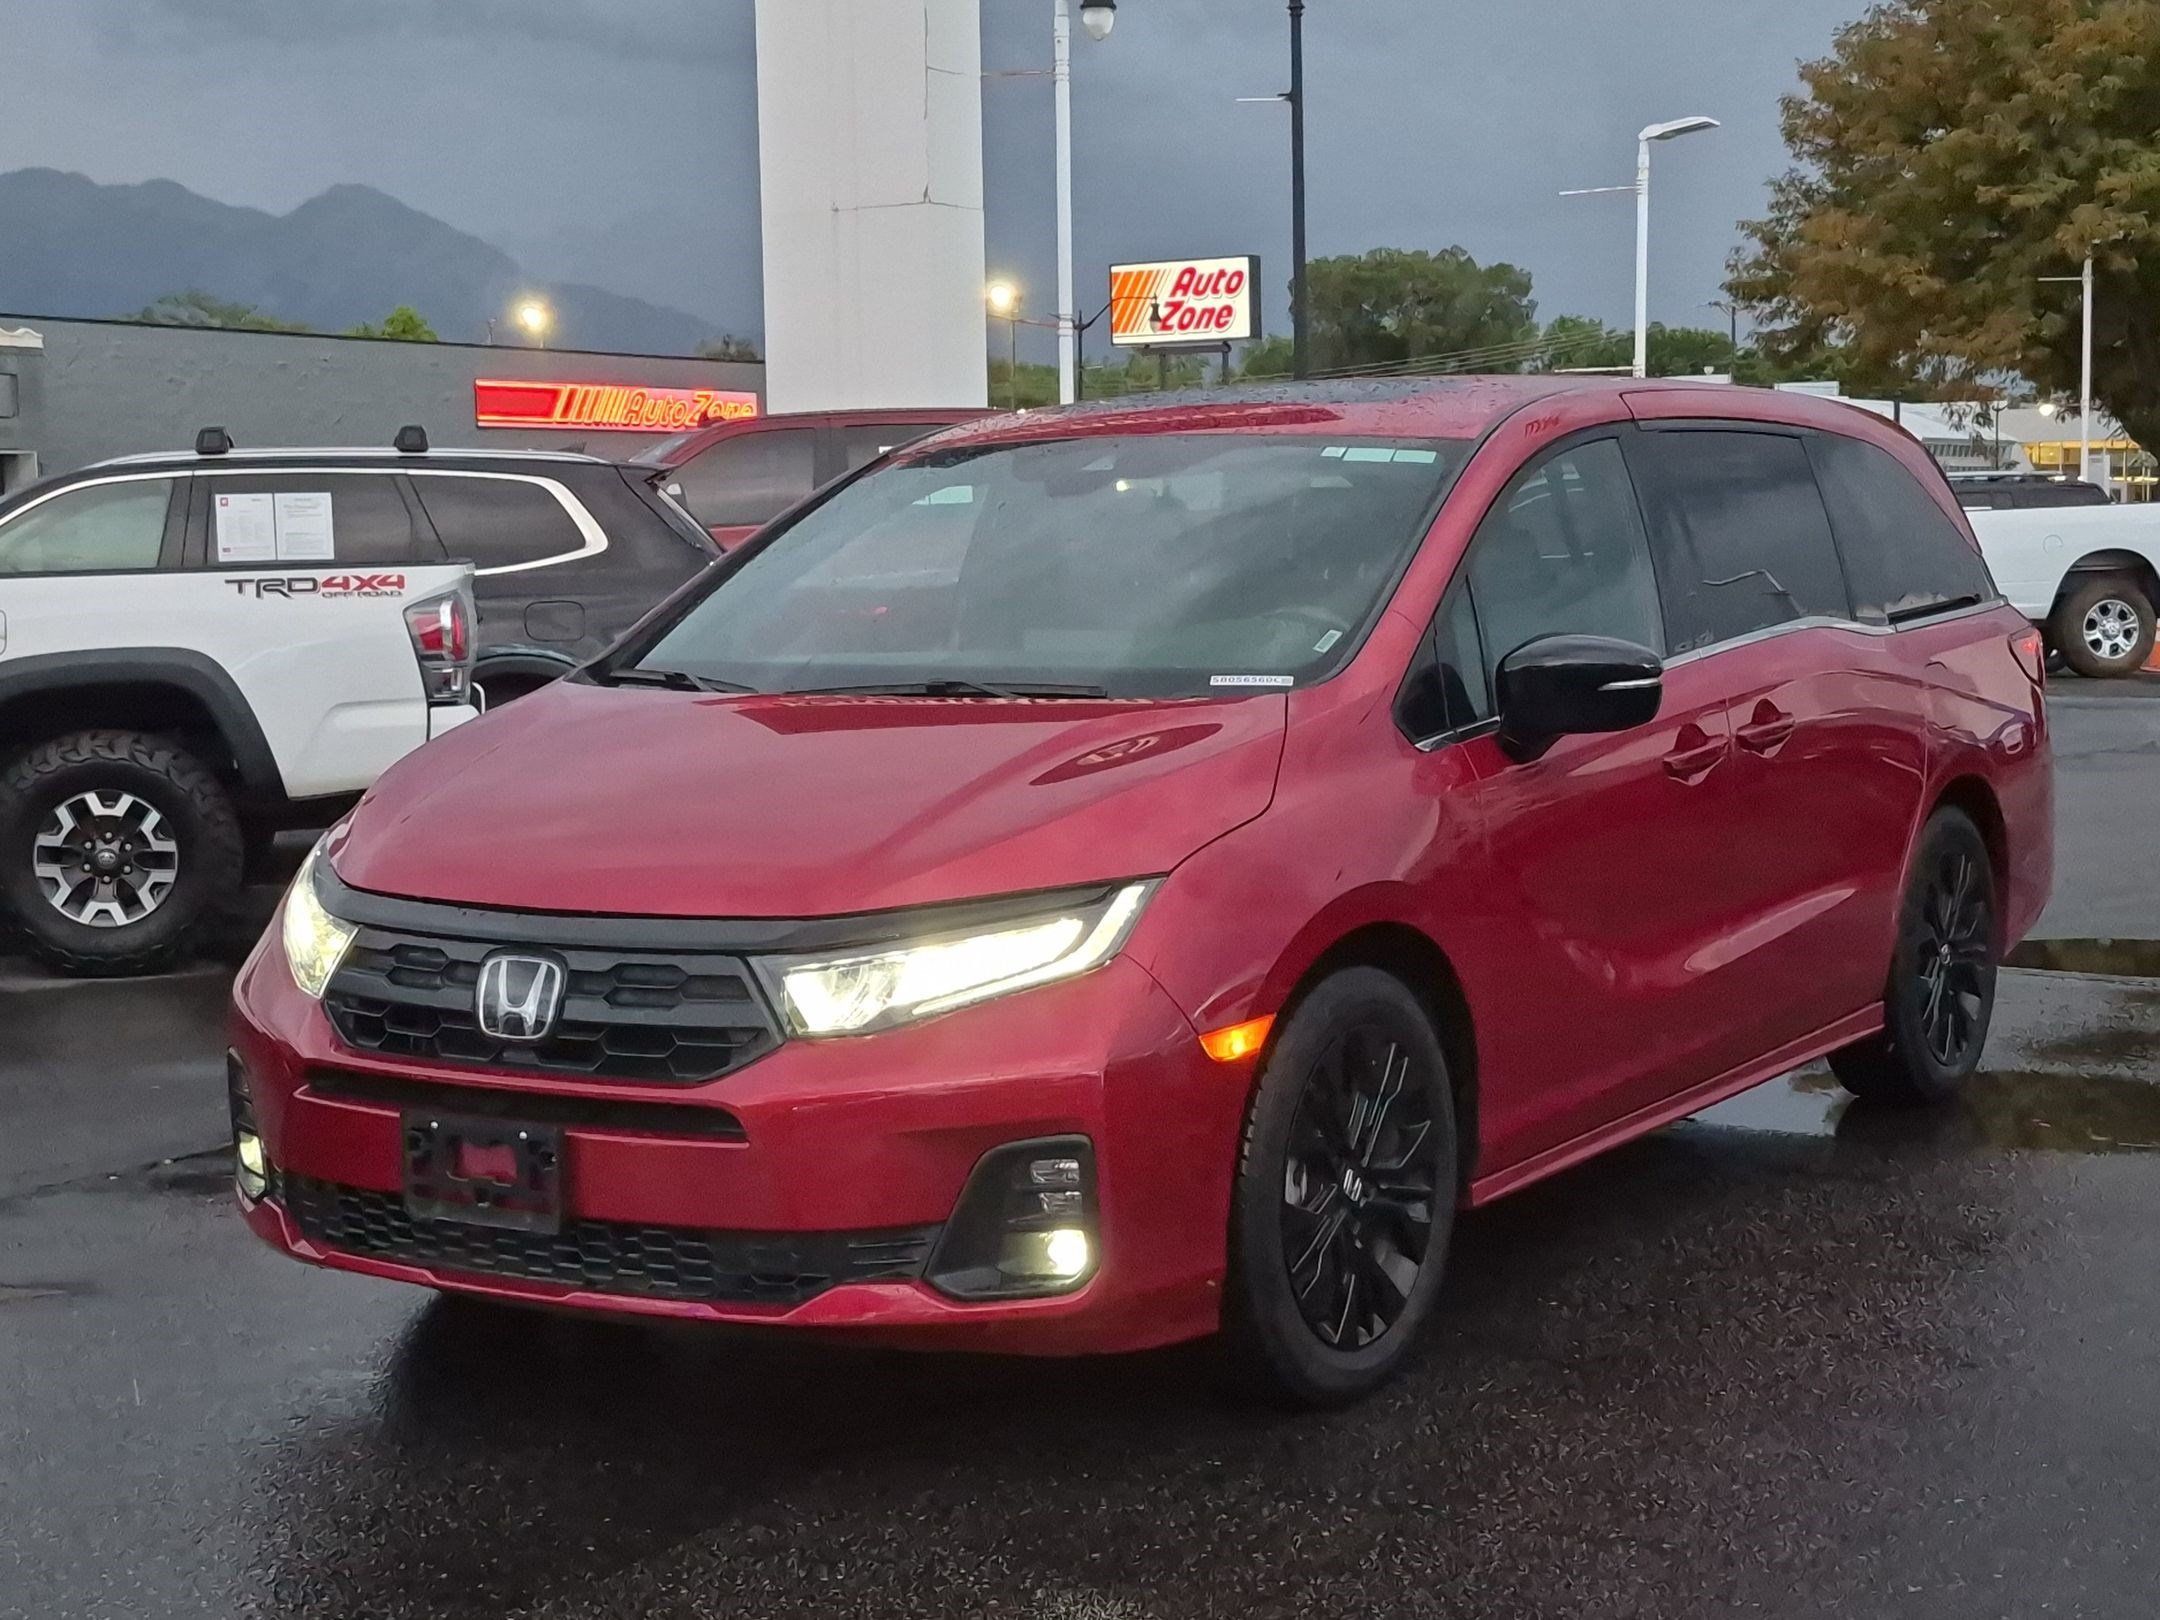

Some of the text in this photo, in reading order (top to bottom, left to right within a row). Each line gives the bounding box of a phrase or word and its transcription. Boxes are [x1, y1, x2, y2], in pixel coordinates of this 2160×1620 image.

[1168, 266, 1245, 298] Auto
[1158, 299, 1234, 332] Zone
[224, 576, 321, 599] TRD
[321, 589, 403, 599] OFF ROAD
